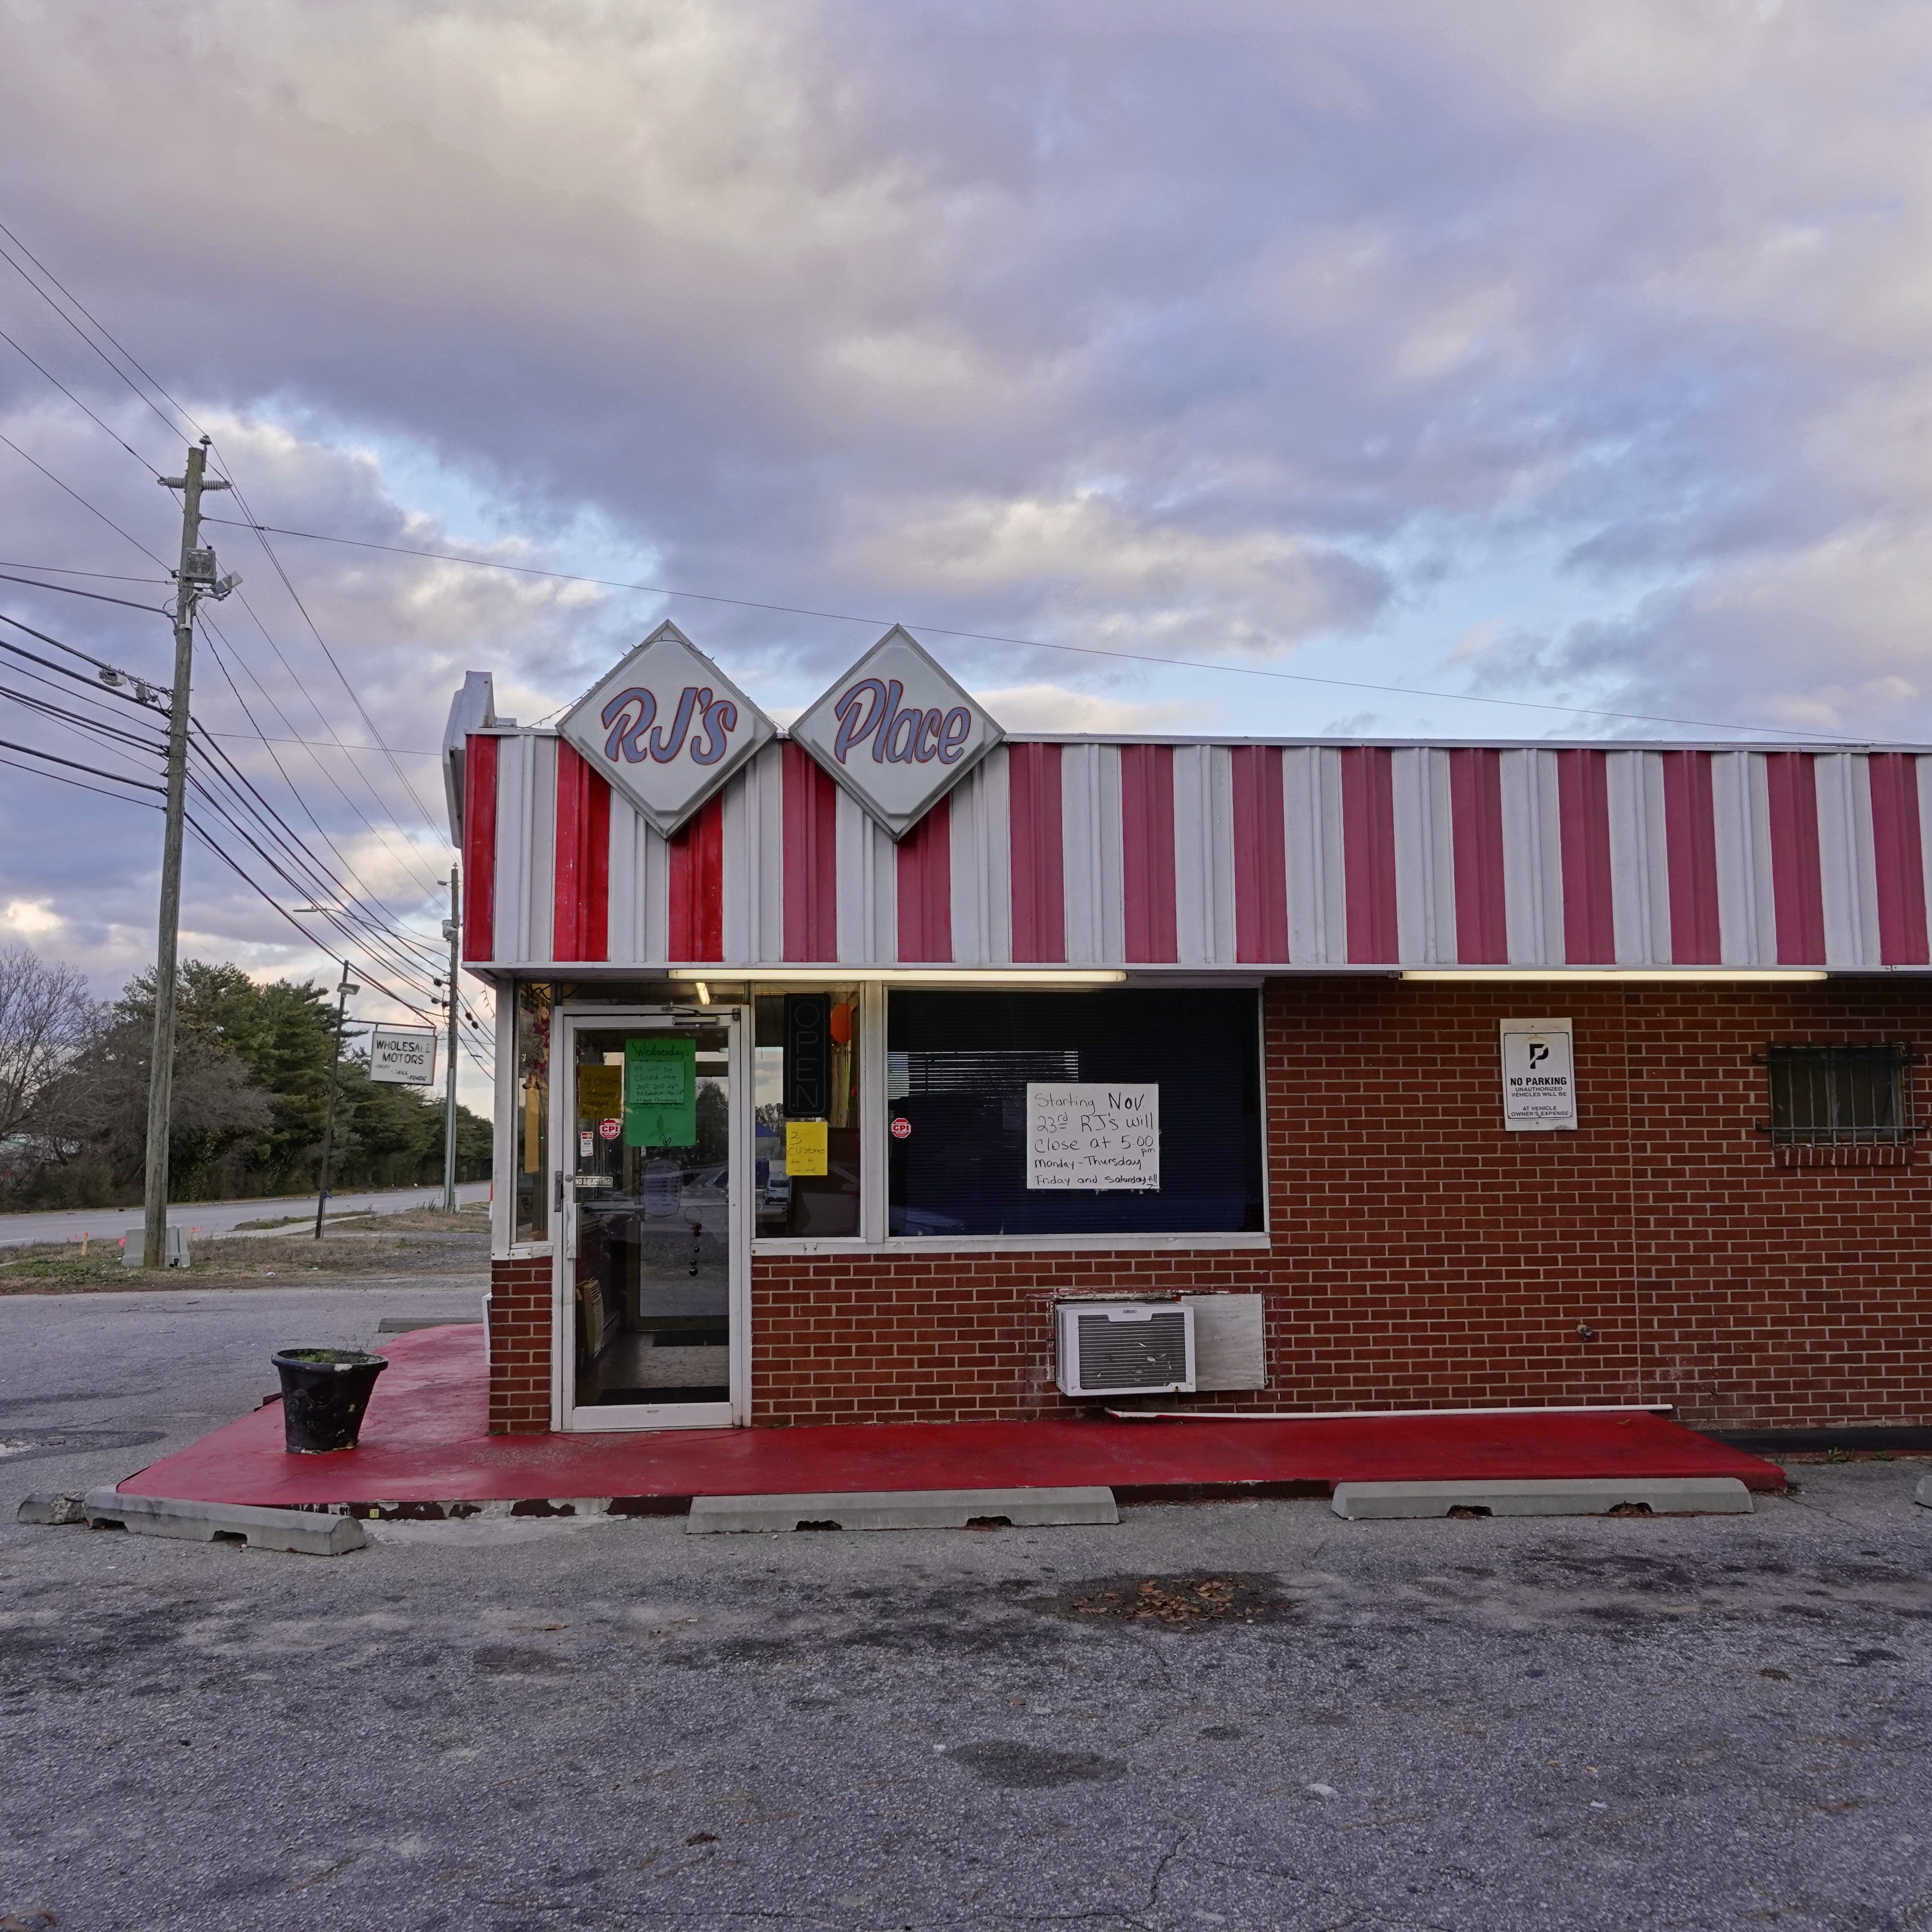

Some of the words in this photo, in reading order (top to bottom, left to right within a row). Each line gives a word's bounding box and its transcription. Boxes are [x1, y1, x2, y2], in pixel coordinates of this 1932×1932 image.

[835, 678, 971, 764] Place
[377, 1040, 432, 1053] WHOLESALE
[382, 1052, 424, 1065] MOTORS
[793, 1003, 820, 1107] OPEN
[1510, 1077, 1523, 1086] NO
[1526, 1077, 1567, 1086] PARKING
[1035, 1093, 1095, 1116] Starting
[790, 1132, 801, 1145] 3
[1090, 1136, 1111, 1148] at
[1121, 1135, 1153, 1149] 5:00
[1141, 1148, 1155, 1157] pm
[1084, 1156, 1141, 1170] Thursday
[1035, 1175, 1070, 1185] Friday
